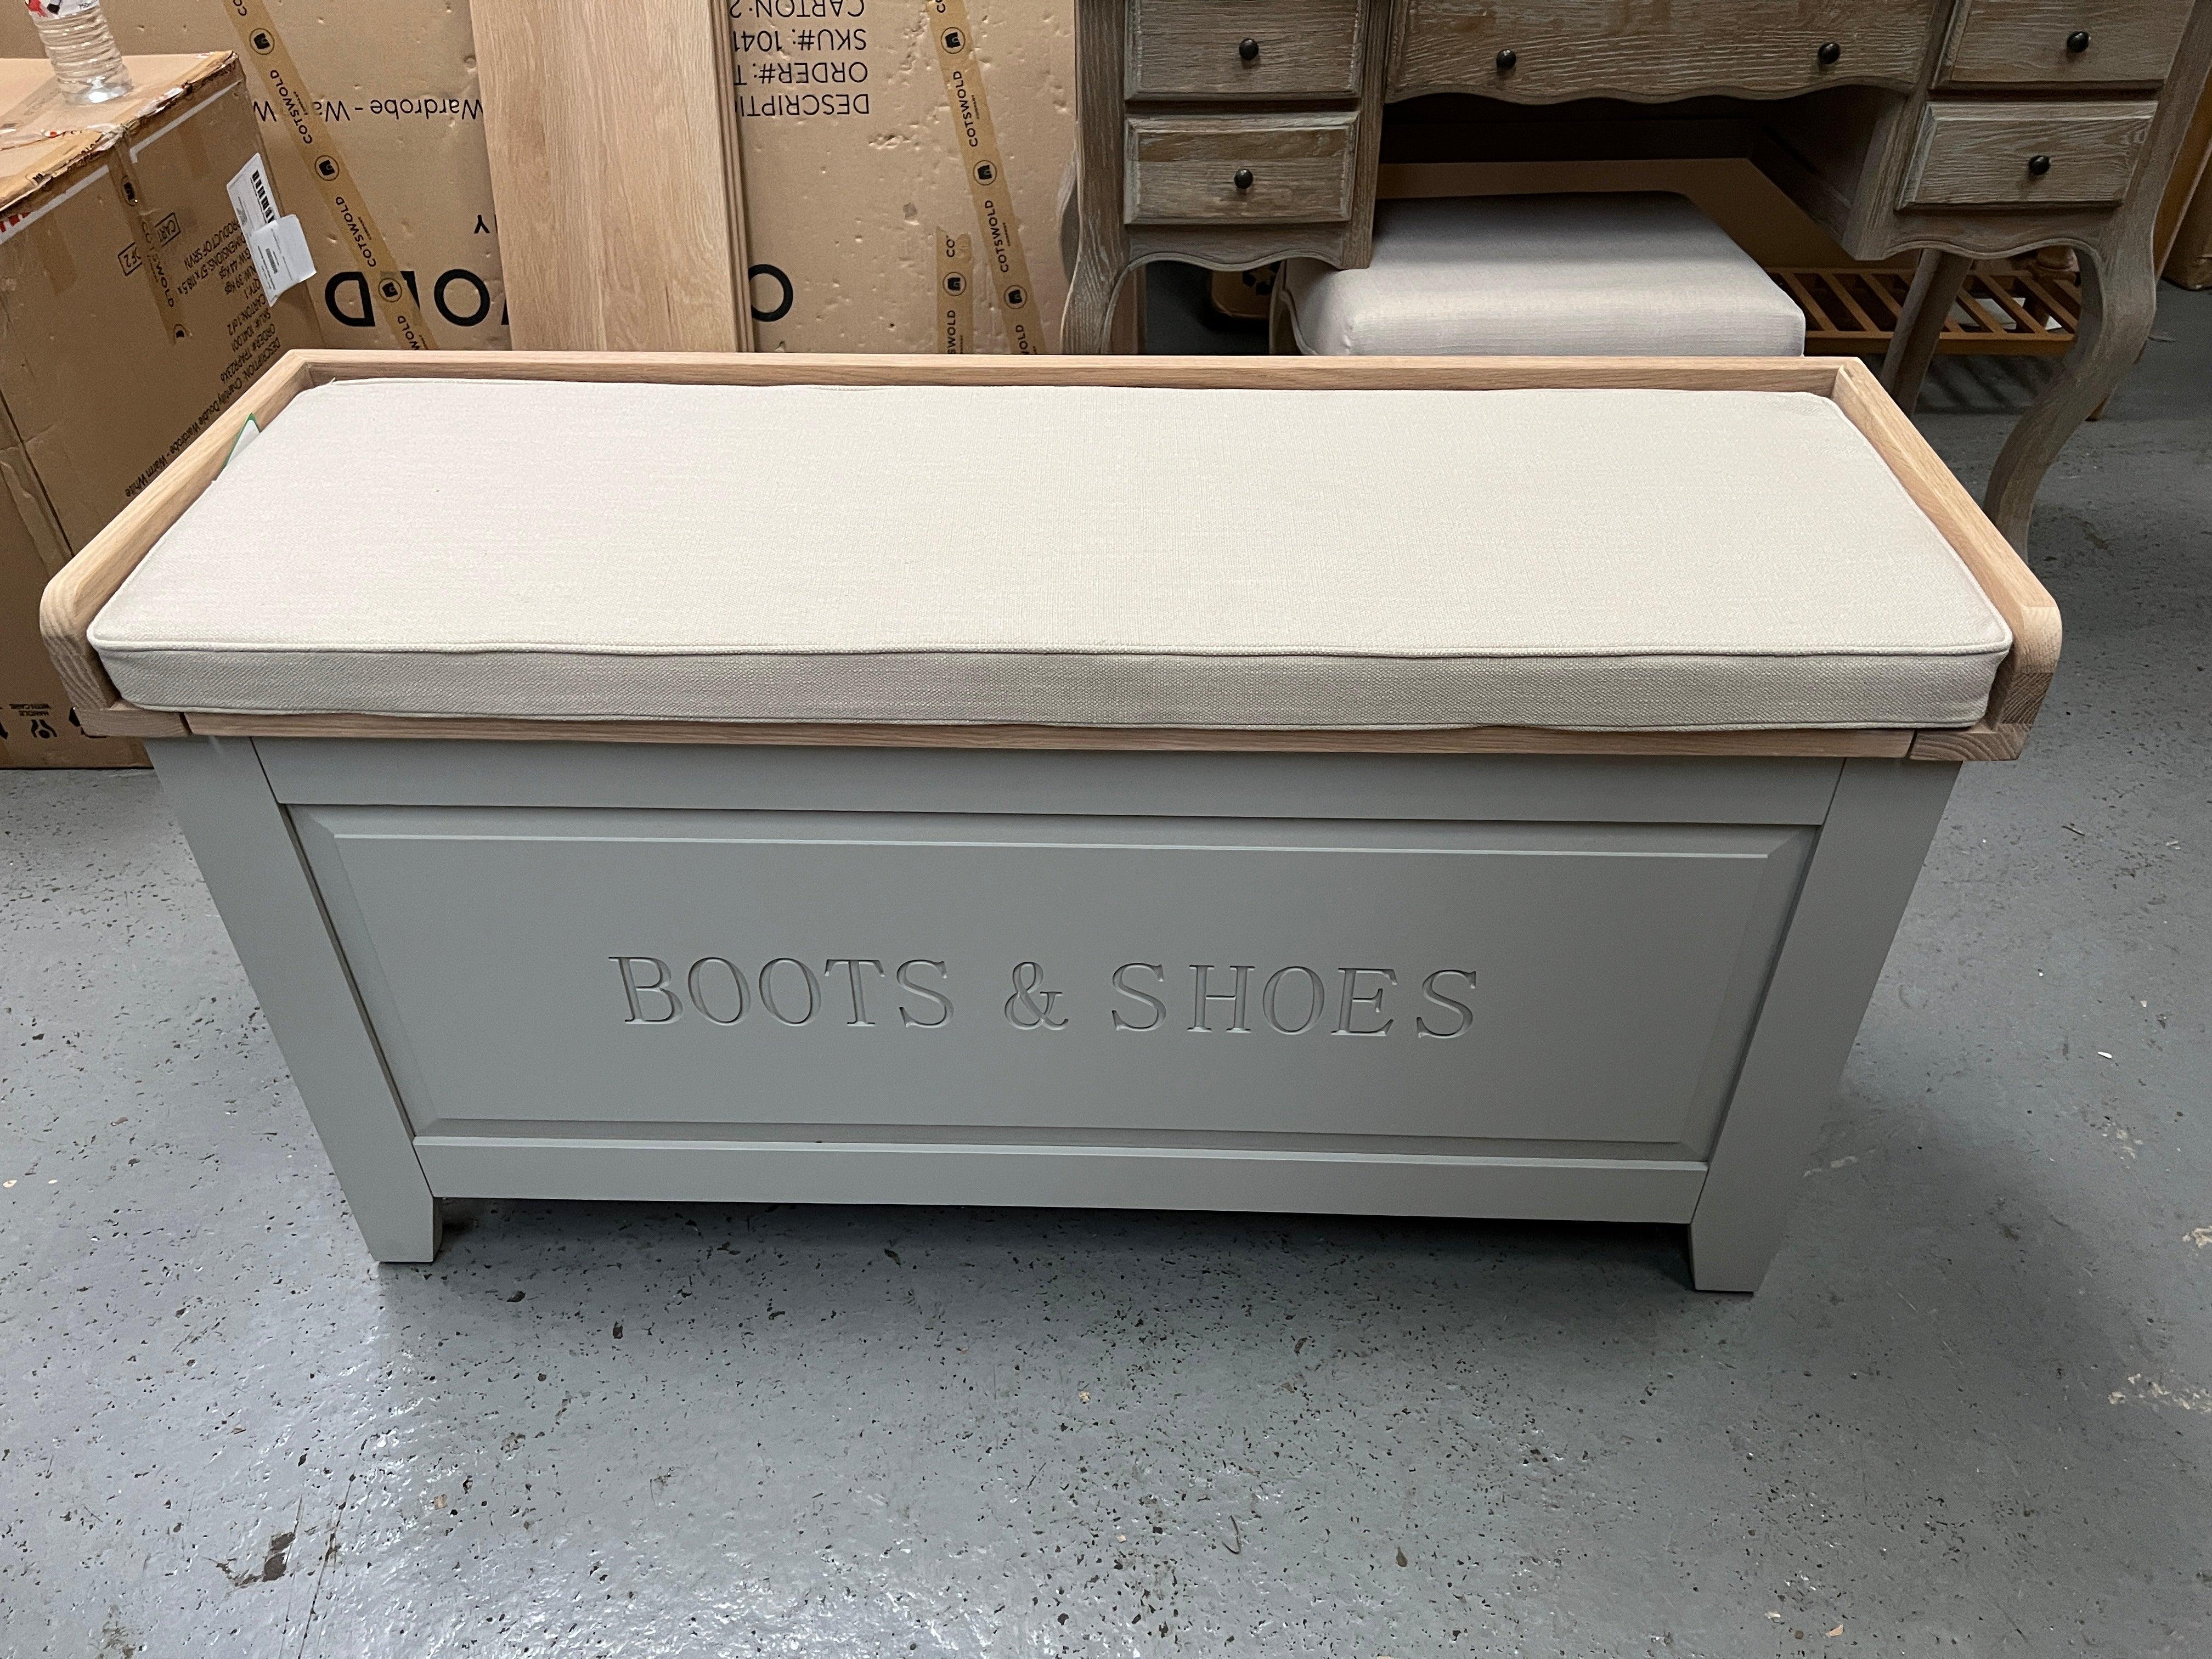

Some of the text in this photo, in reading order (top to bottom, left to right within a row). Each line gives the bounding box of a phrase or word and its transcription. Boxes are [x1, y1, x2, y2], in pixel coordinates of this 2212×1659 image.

[792, 29, 866, 50] SKU#:
[752, 61, 868, 84] ORDER#:
[270, 70, 312, 144] COTSWOLD
[735, 94, 869, 117] DESCRIPTI
[953, 71, 978, 147] COTSWOLD
[336, 196, 376, 267] COTSWOLD
[985, 200, 1009, 273] COTSWOLD
[125, 473, 148, 497] White
[145, 455, 168, 478] Warm
[609, 957, 1477, 1039] BOOTS & SHOES
